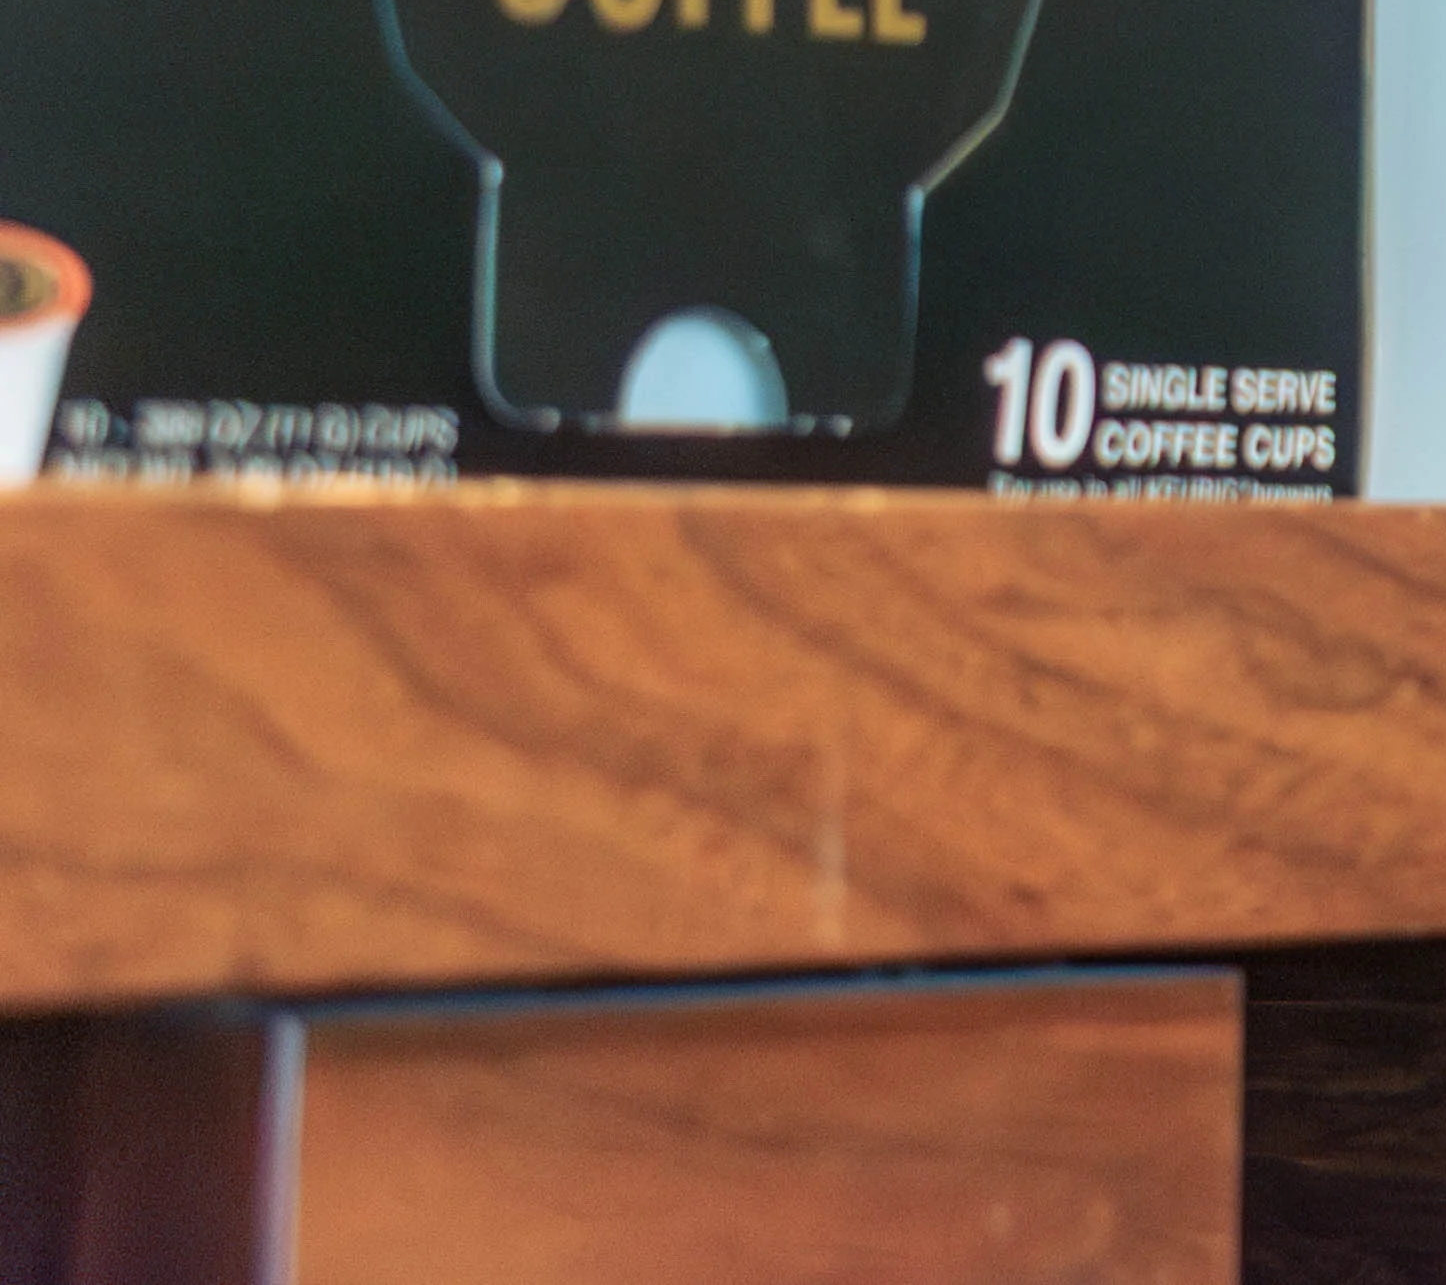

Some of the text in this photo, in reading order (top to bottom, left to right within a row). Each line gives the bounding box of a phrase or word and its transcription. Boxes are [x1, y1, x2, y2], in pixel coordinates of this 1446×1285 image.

[984, 336, 1336, 470] 10 SINGLE SERVE
[1095, 420, 1336, 471] COFFEE CUPS
